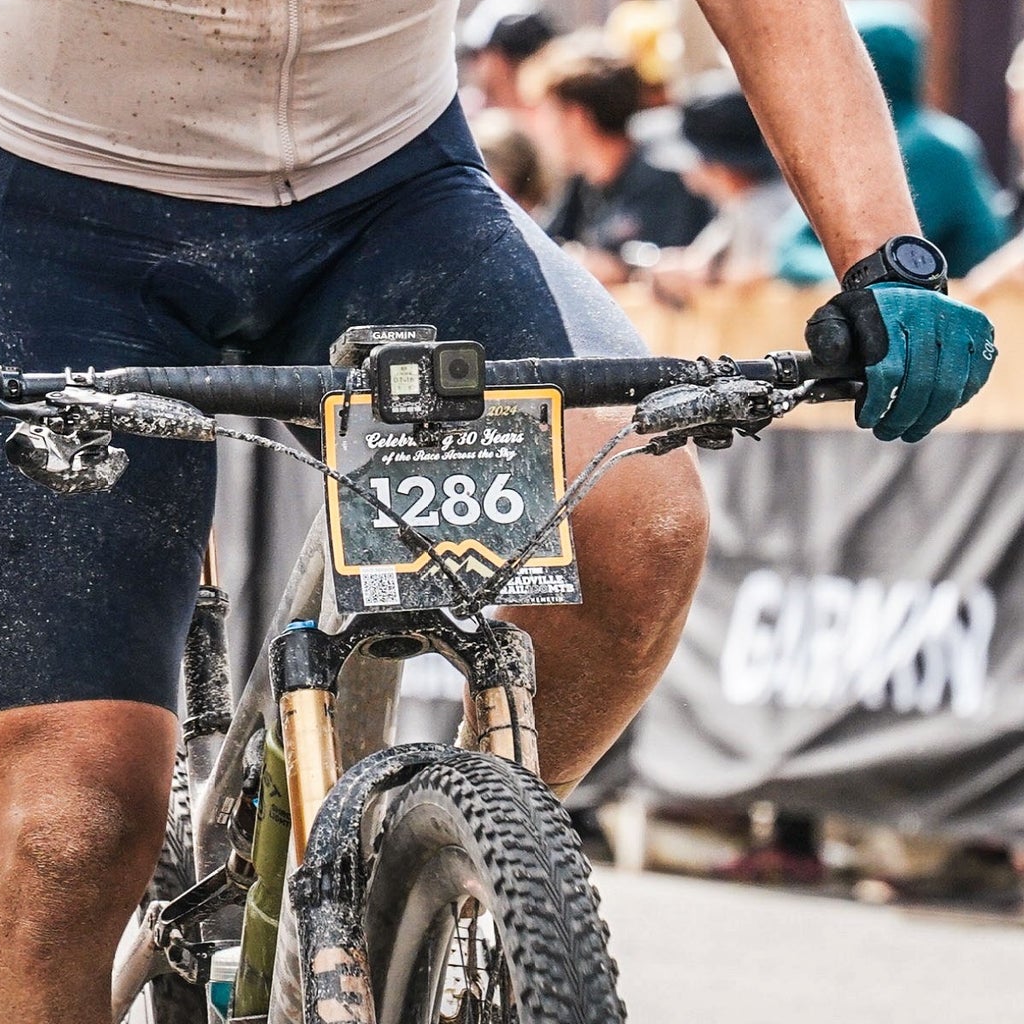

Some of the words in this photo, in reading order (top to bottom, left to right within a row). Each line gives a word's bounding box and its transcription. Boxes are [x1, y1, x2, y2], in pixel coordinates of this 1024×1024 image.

[373, 331, 416, 339] GARMIN
[487, 406, 518, 417] 2024
[365, 432, 454, 451] Celebrg
[457, 431, 478, 445] 30
[481, 428, 525, 445] Years
[382, 451, 394, 465] of
[395, 451, 411, 461] the
[413, 449, 440, 461] Race
[441, 449, 476, 461] Across
[478, 448, 494, 459] the
[495, 447, 517, 461] Sky
[369, 472, 525, 529] 1286
